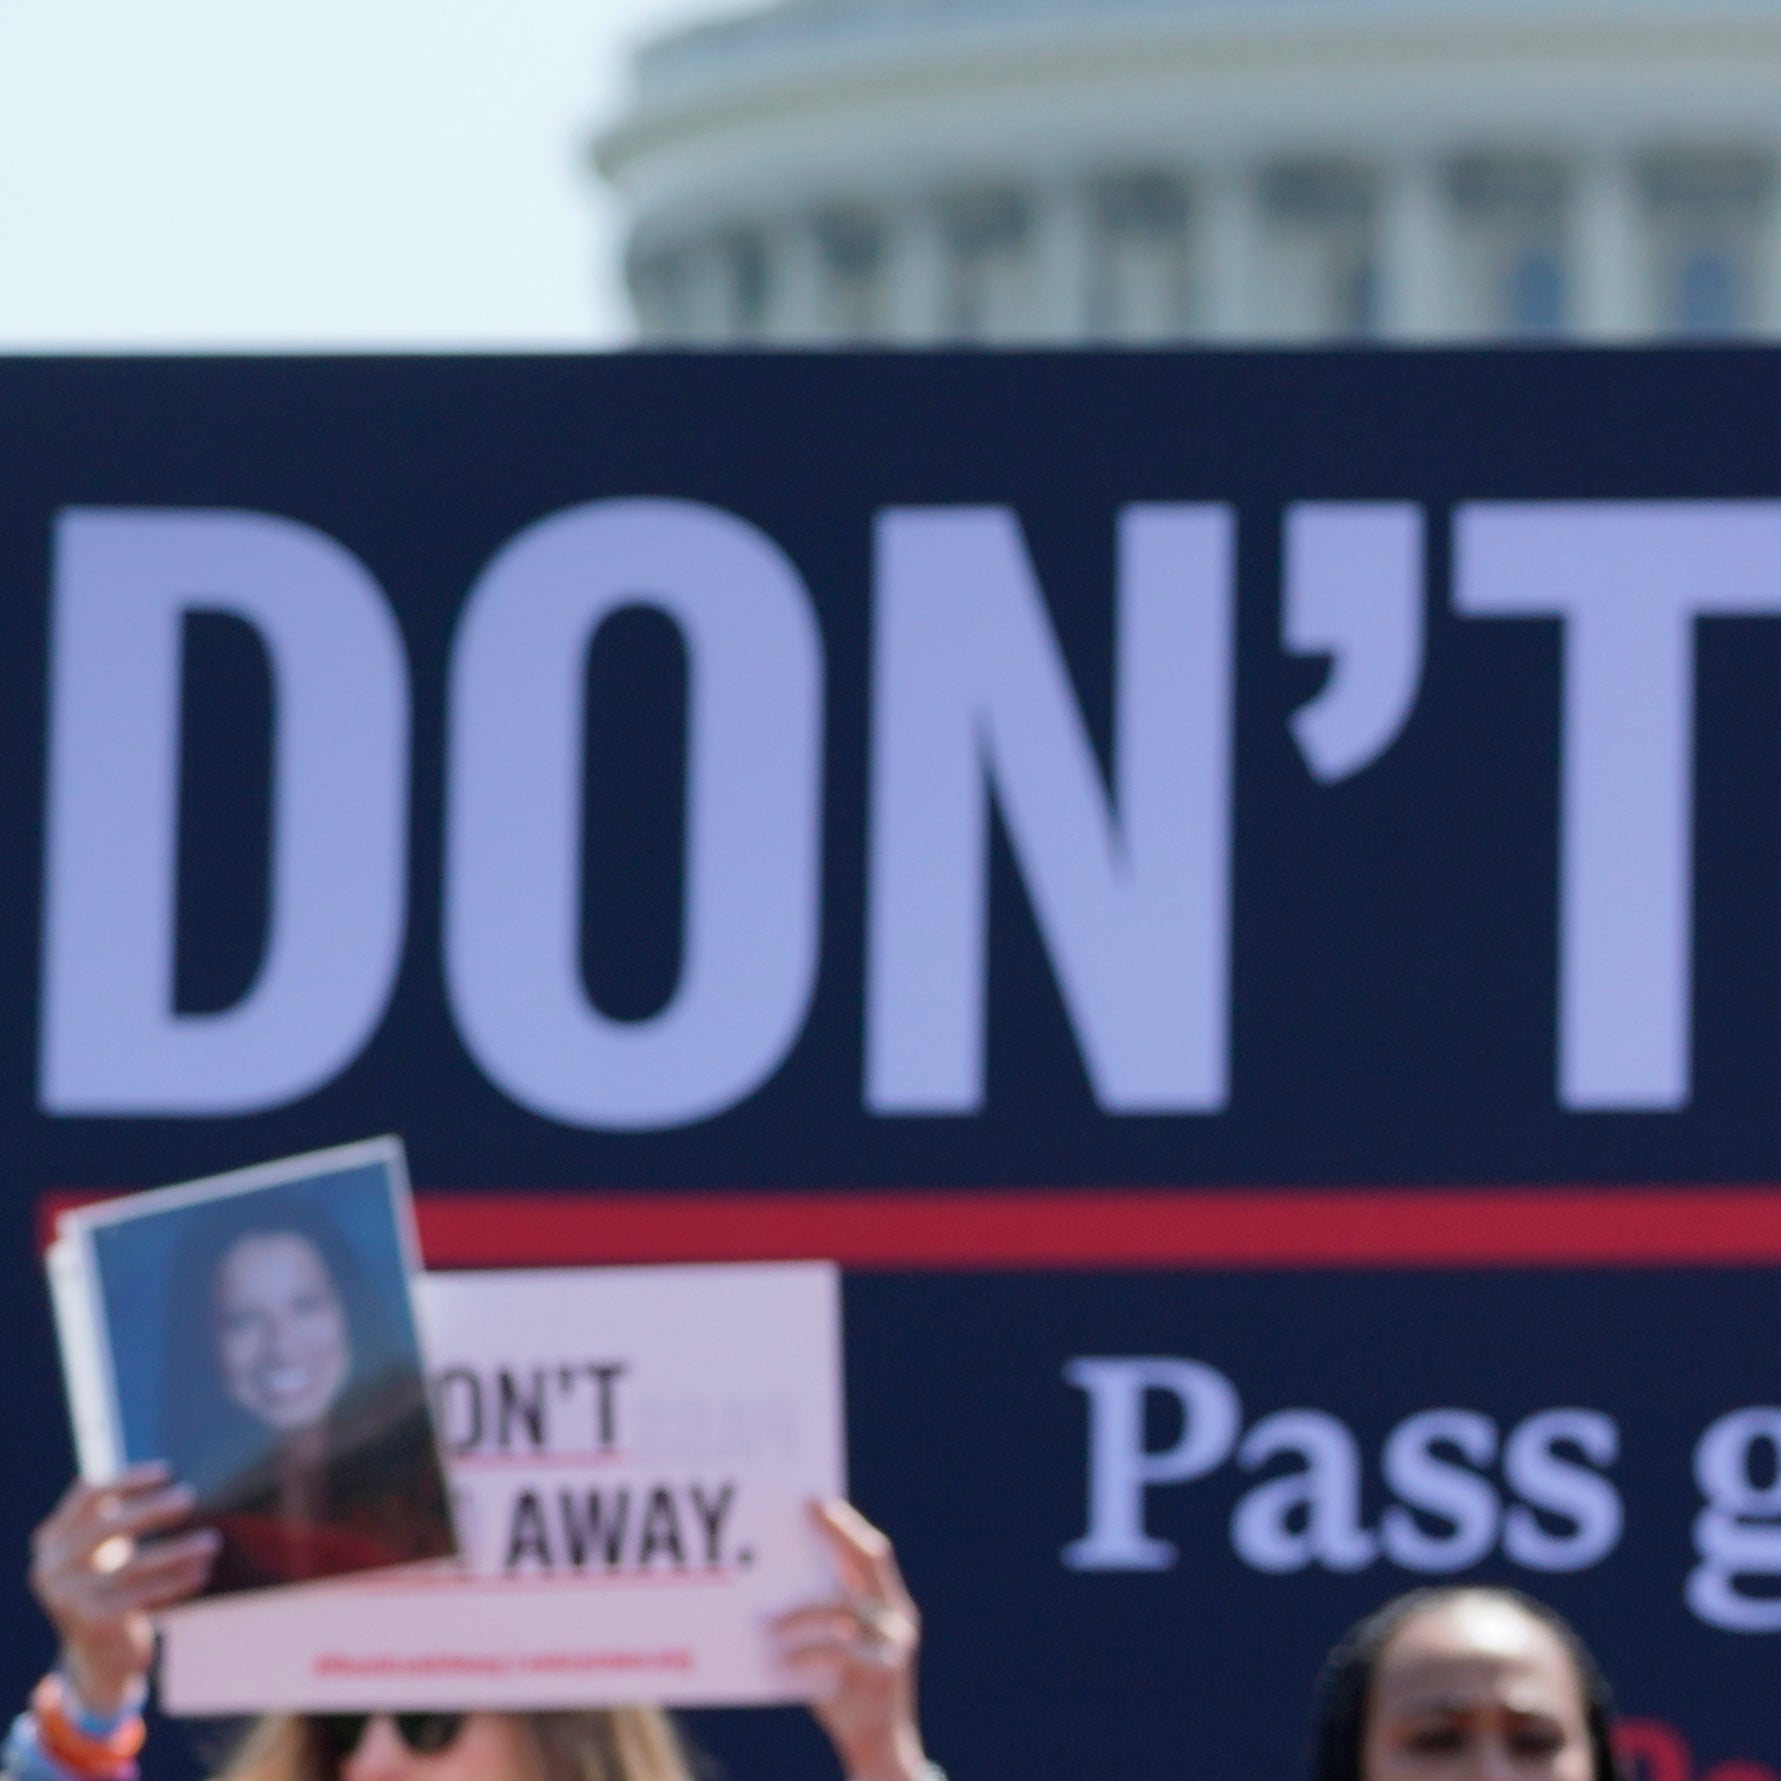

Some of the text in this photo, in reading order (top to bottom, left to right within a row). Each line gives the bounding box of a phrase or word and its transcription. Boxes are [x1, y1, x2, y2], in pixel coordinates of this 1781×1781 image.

[439, 1360, 626, 1450] ON'T
[1061, 1356, 1623, 1573] Pass
[505, 1482, 753, 1569] AWAY.
